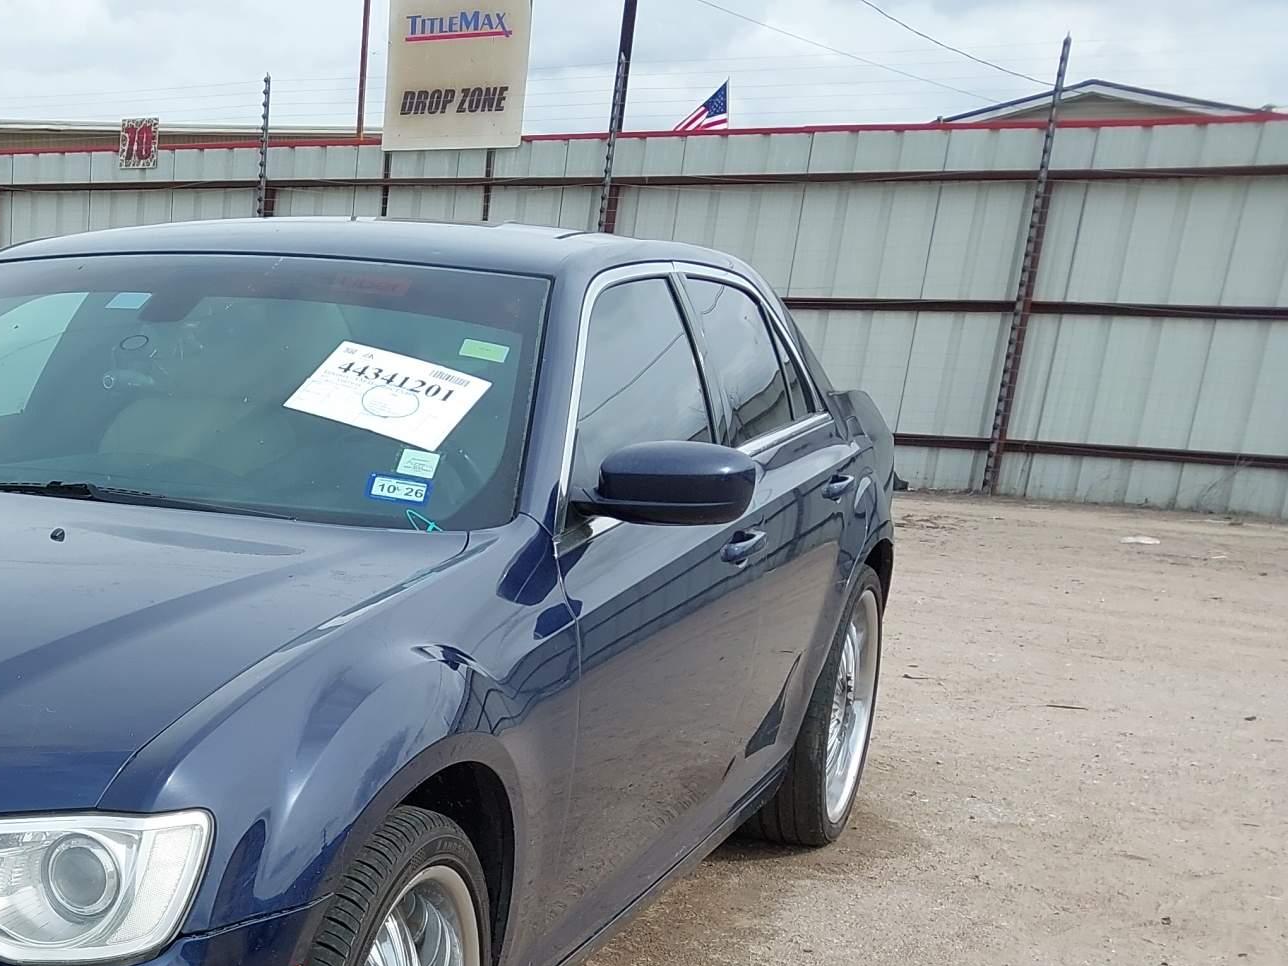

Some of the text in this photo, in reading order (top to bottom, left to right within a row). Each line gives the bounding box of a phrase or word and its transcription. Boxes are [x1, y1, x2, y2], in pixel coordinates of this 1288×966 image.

[400, 86, 509, 116] DROP ZONE
[338, 361, 455, 402] 44341201
